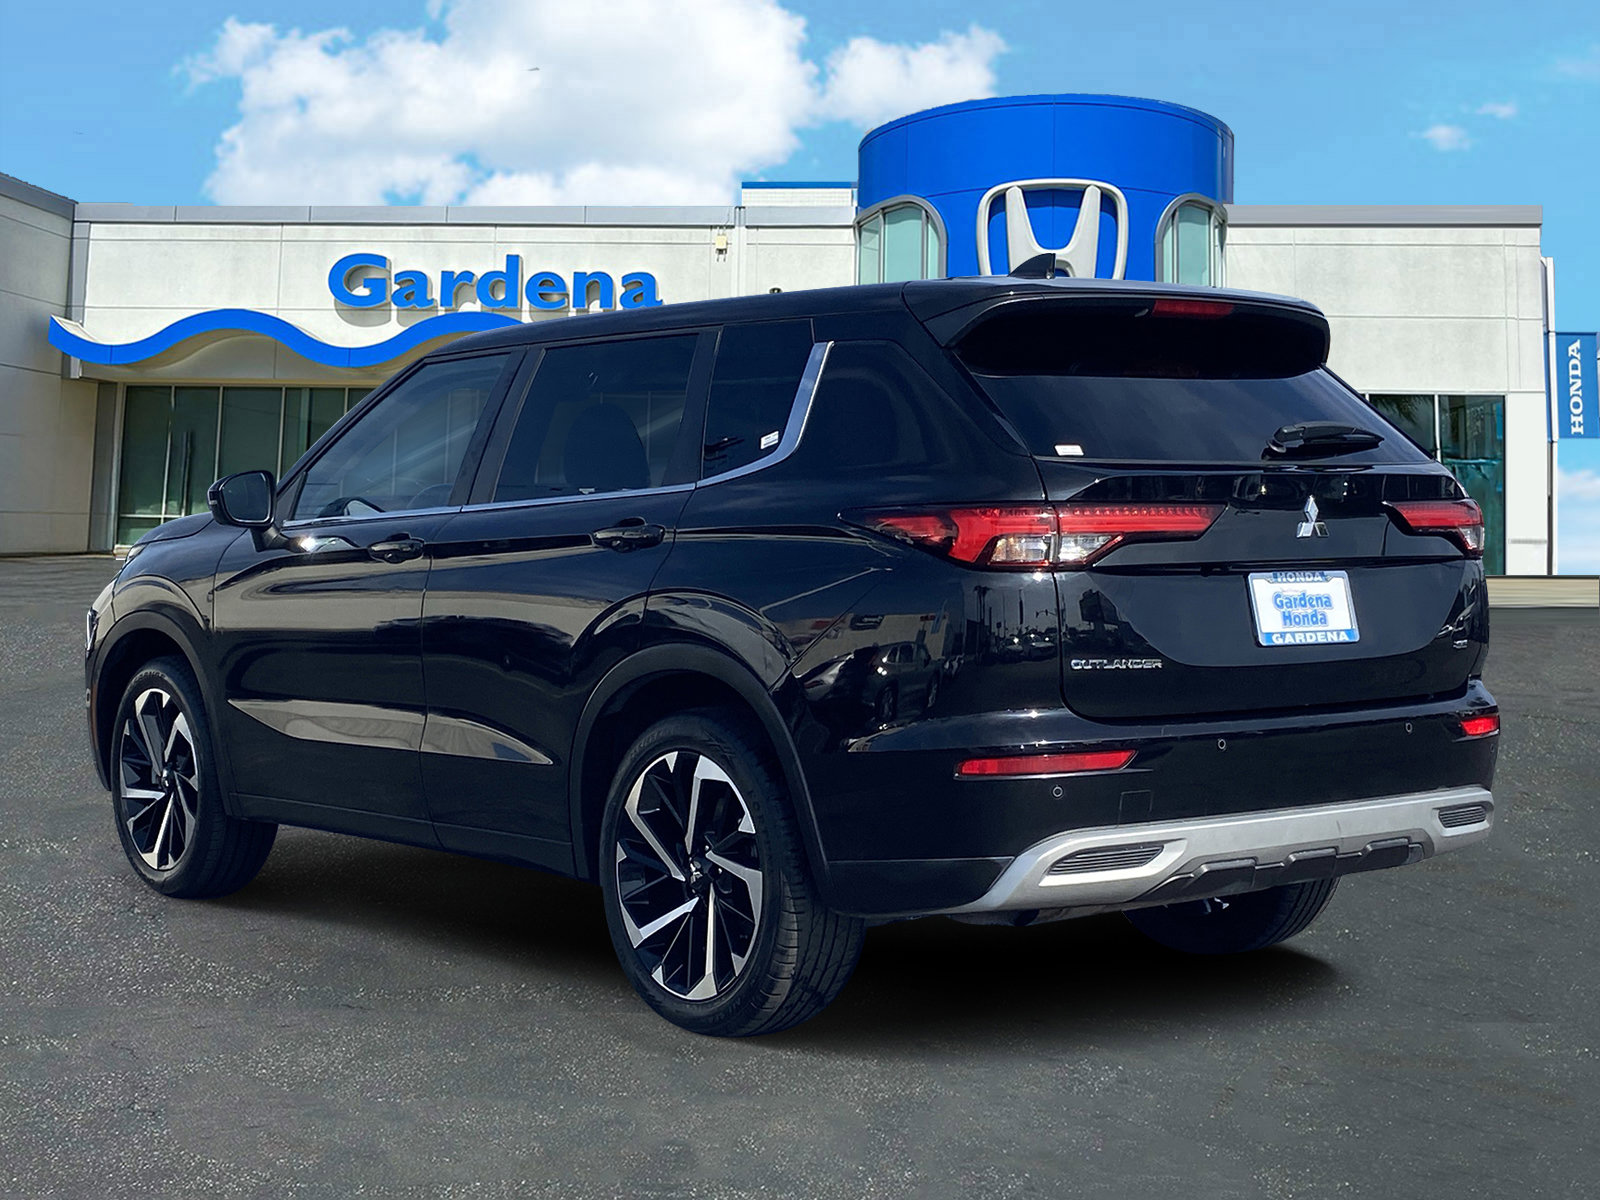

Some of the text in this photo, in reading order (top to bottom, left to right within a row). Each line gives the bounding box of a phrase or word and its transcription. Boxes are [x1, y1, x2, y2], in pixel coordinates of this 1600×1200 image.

[328, 253, 664, 309] Gardena
[1568, 339, 1584, 435] HONDA
[1276, 571, 1323, 582] HONDA
[1273, 591, 1333, 610] Gardena
[1281, 609, 1328, 627] Honda
[1271, 631, 1350, 645] GARDENA
[1070, 659, 1163, 670] OUTLANDER
